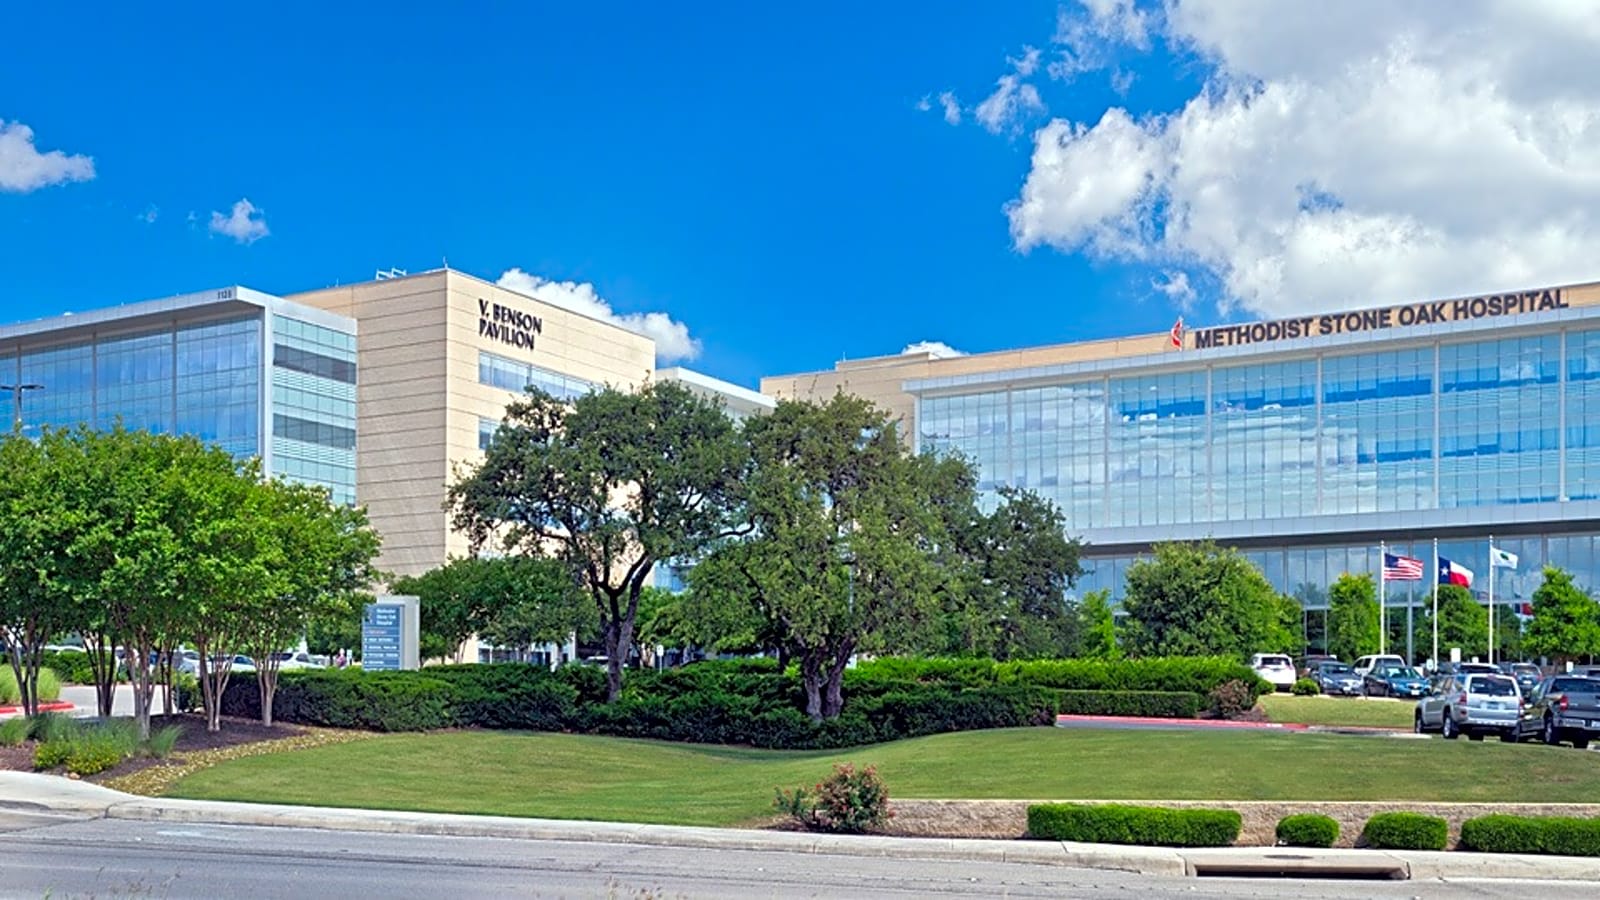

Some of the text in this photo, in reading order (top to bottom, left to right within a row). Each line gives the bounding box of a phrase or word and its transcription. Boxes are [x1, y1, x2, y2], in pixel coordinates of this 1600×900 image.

[478, 298, 542, 335] V. BENSON
[479, 318, 535, 350] PAVILION
[1195, 288, 1569, 349] METHODIST STONE OAK HOSPITAL
